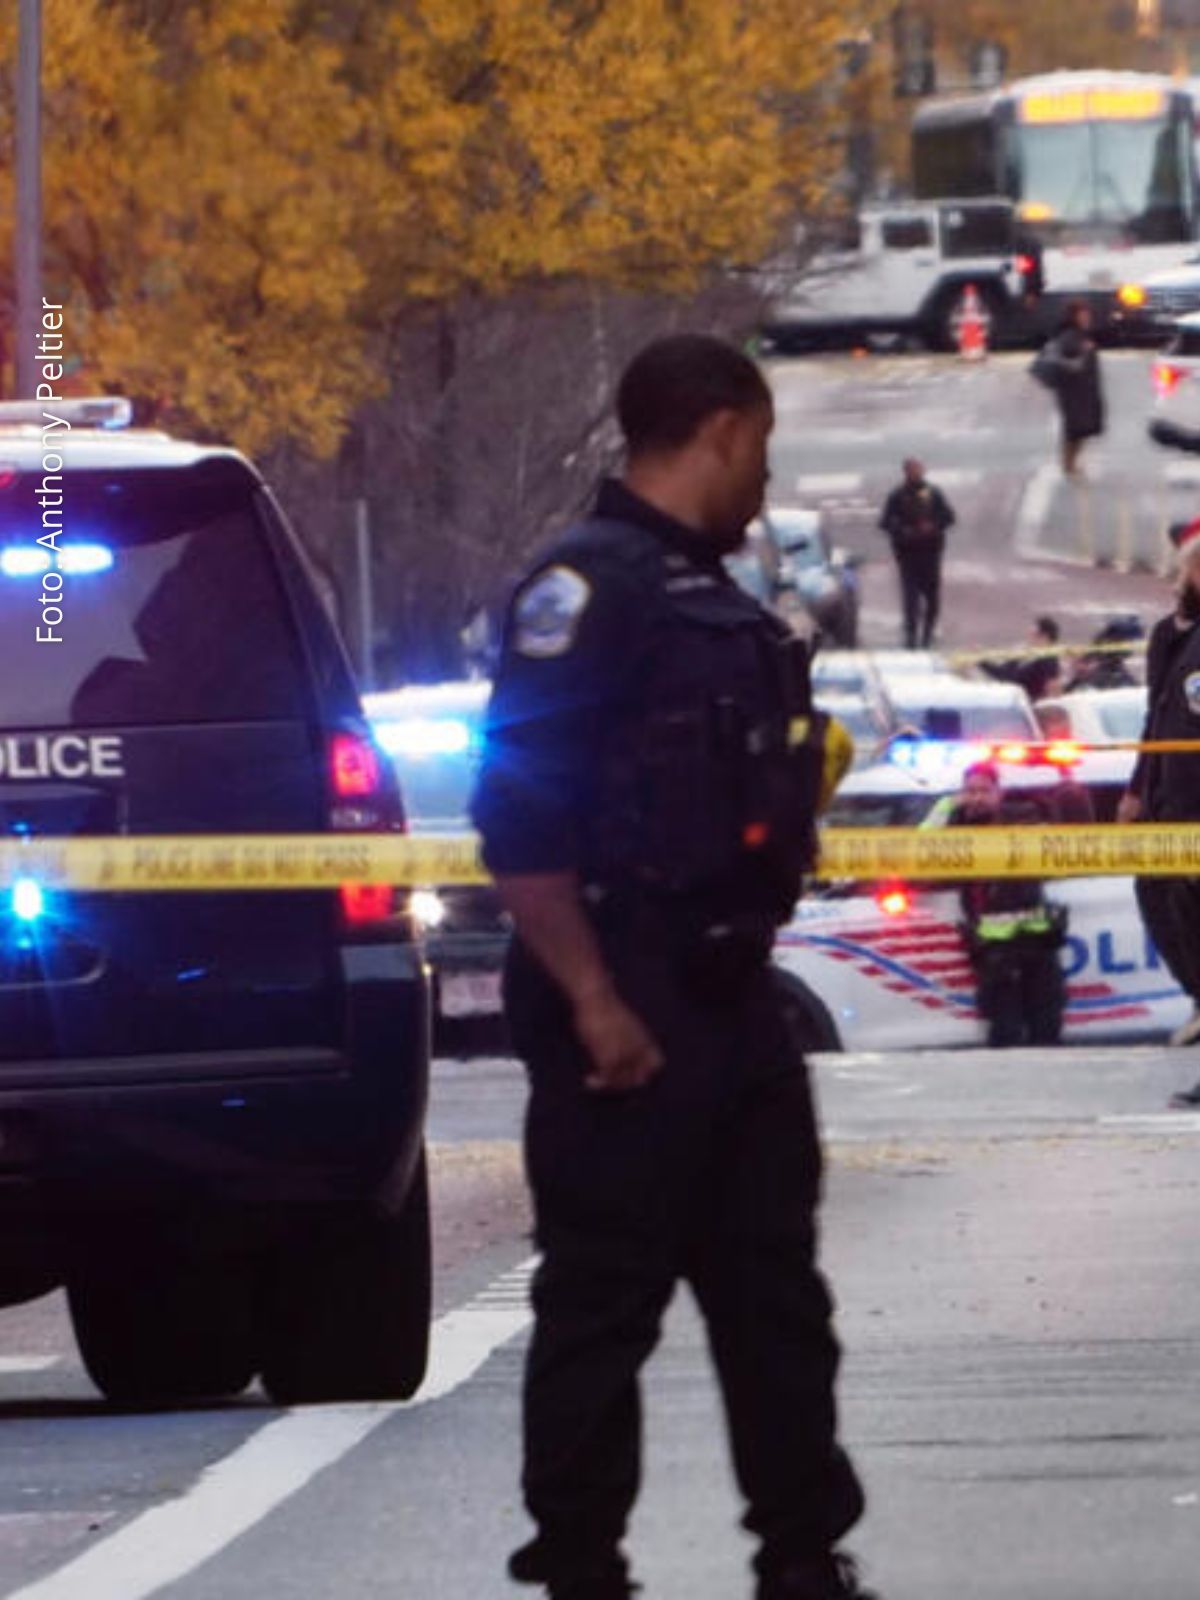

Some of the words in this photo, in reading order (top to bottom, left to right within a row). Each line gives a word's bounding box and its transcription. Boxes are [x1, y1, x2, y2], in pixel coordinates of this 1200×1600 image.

[0, 735, 125, 778] LICE
[915, 836, 973, 868] CROSS
[1040, 835, 1102, 868] POLICE
[1109, 834, 1146, 867] LINE
[1154, 834, 1177, 867] DO
